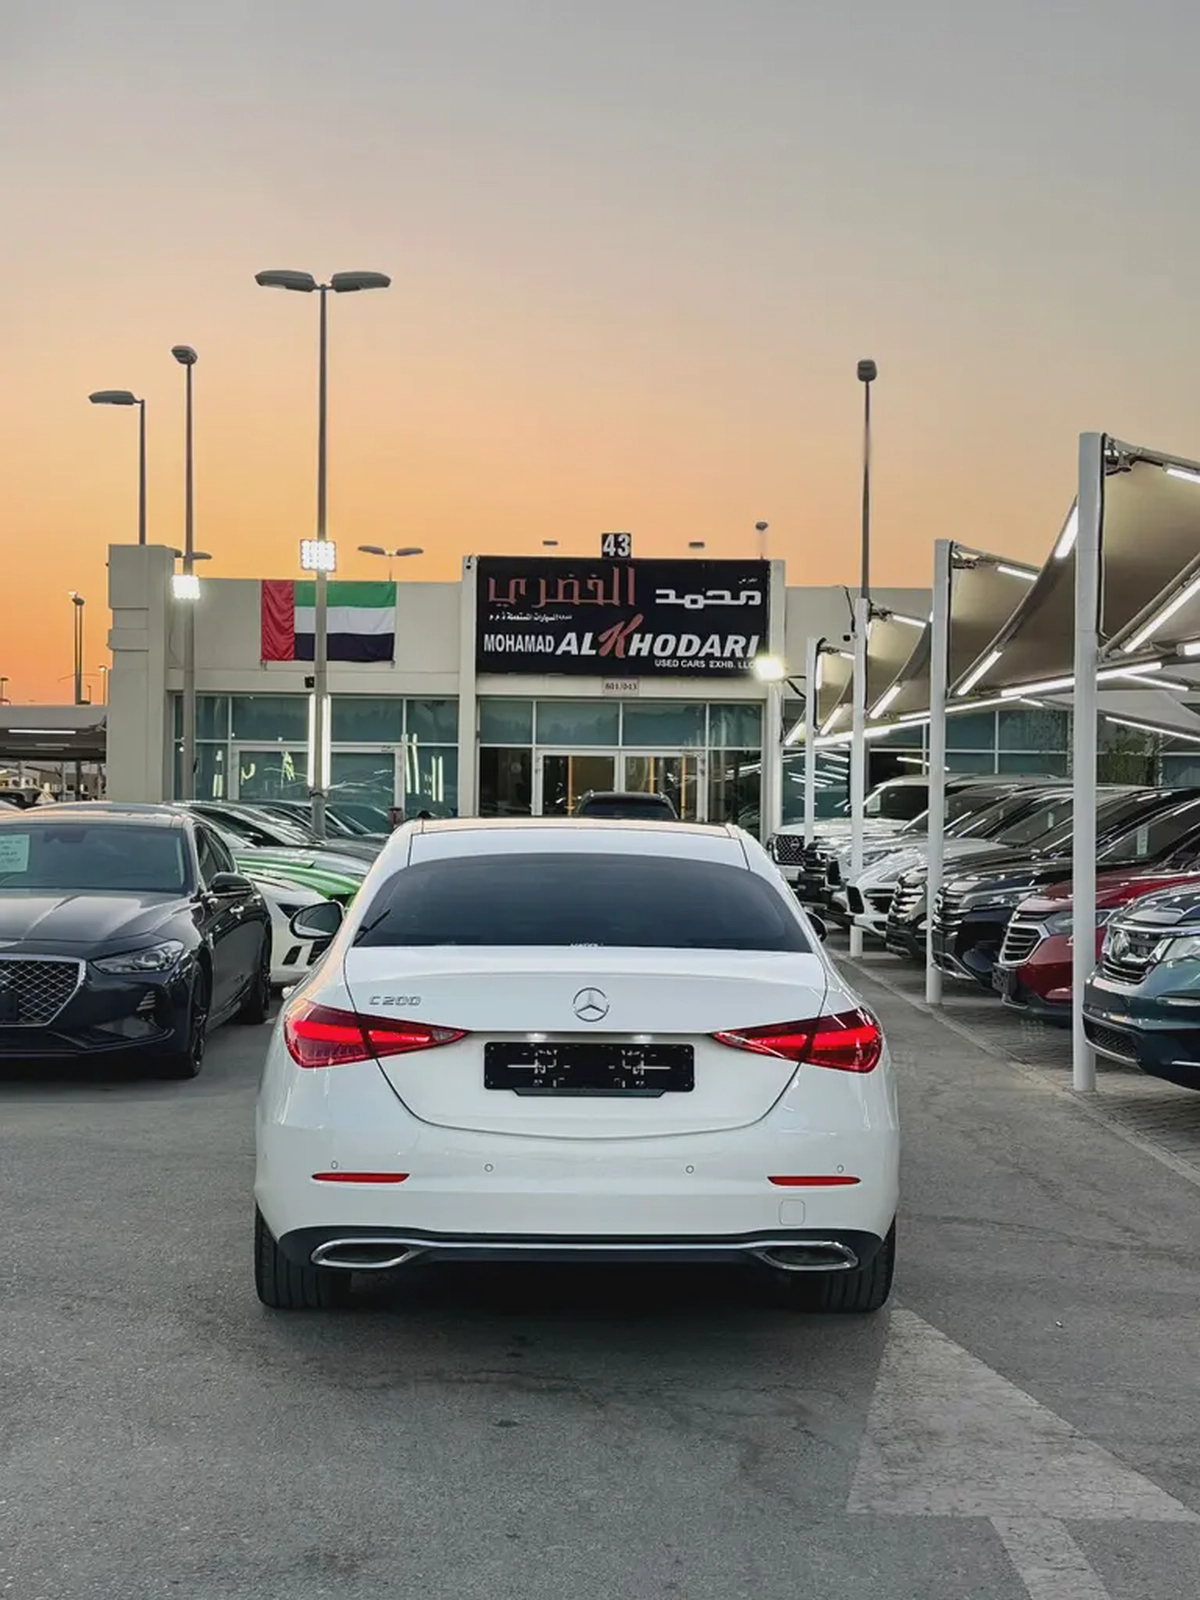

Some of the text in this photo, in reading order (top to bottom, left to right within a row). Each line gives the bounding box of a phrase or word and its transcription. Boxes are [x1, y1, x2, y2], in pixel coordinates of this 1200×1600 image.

[603, 533, 631, 557] 43
[488, 565, 762, 609] محمد الخضري
[483, 633, 555, 653] MOHAMAD
[654, 658, 679, 668] USED
[680, 659, 706, 668] CARS
